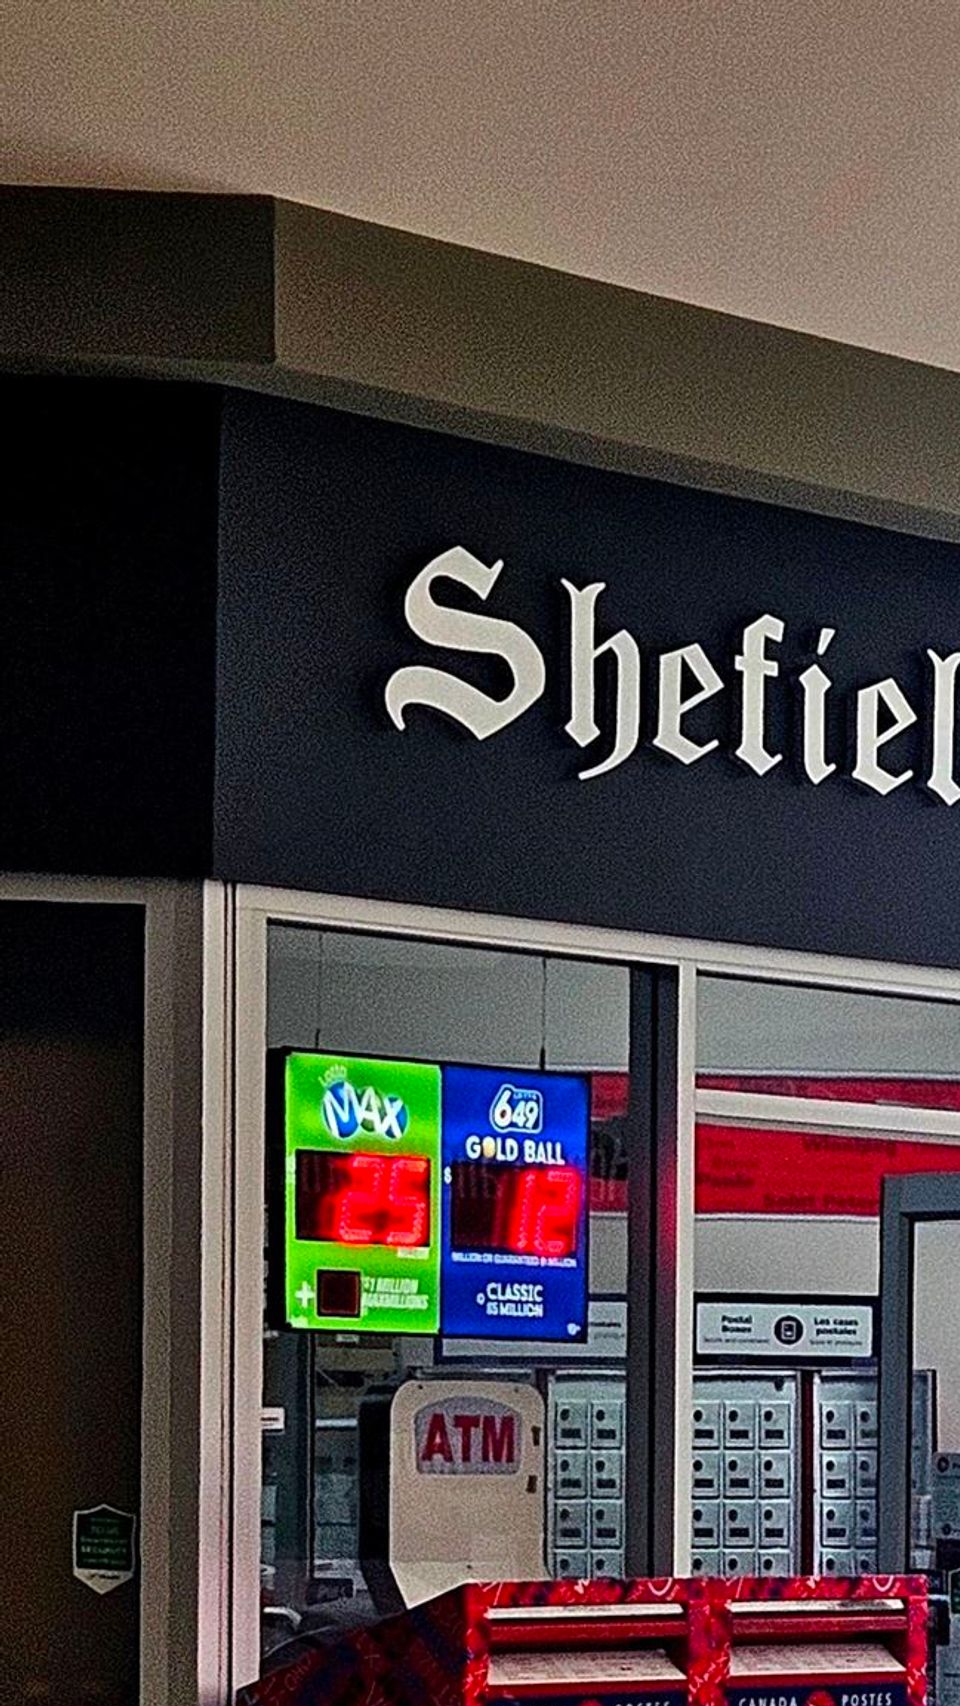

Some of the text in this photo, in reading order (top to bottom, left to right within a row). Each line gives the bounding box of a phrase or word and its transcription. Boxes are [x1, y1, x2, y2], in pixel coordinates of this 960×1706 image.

[322, 1079, 408, 1139] MAX
[466, 1135, 566, 1165] GOLD BALL
[486, 1282, 543, 1302] CLASSIC
[420, 1413, 515, 1462] ATM
